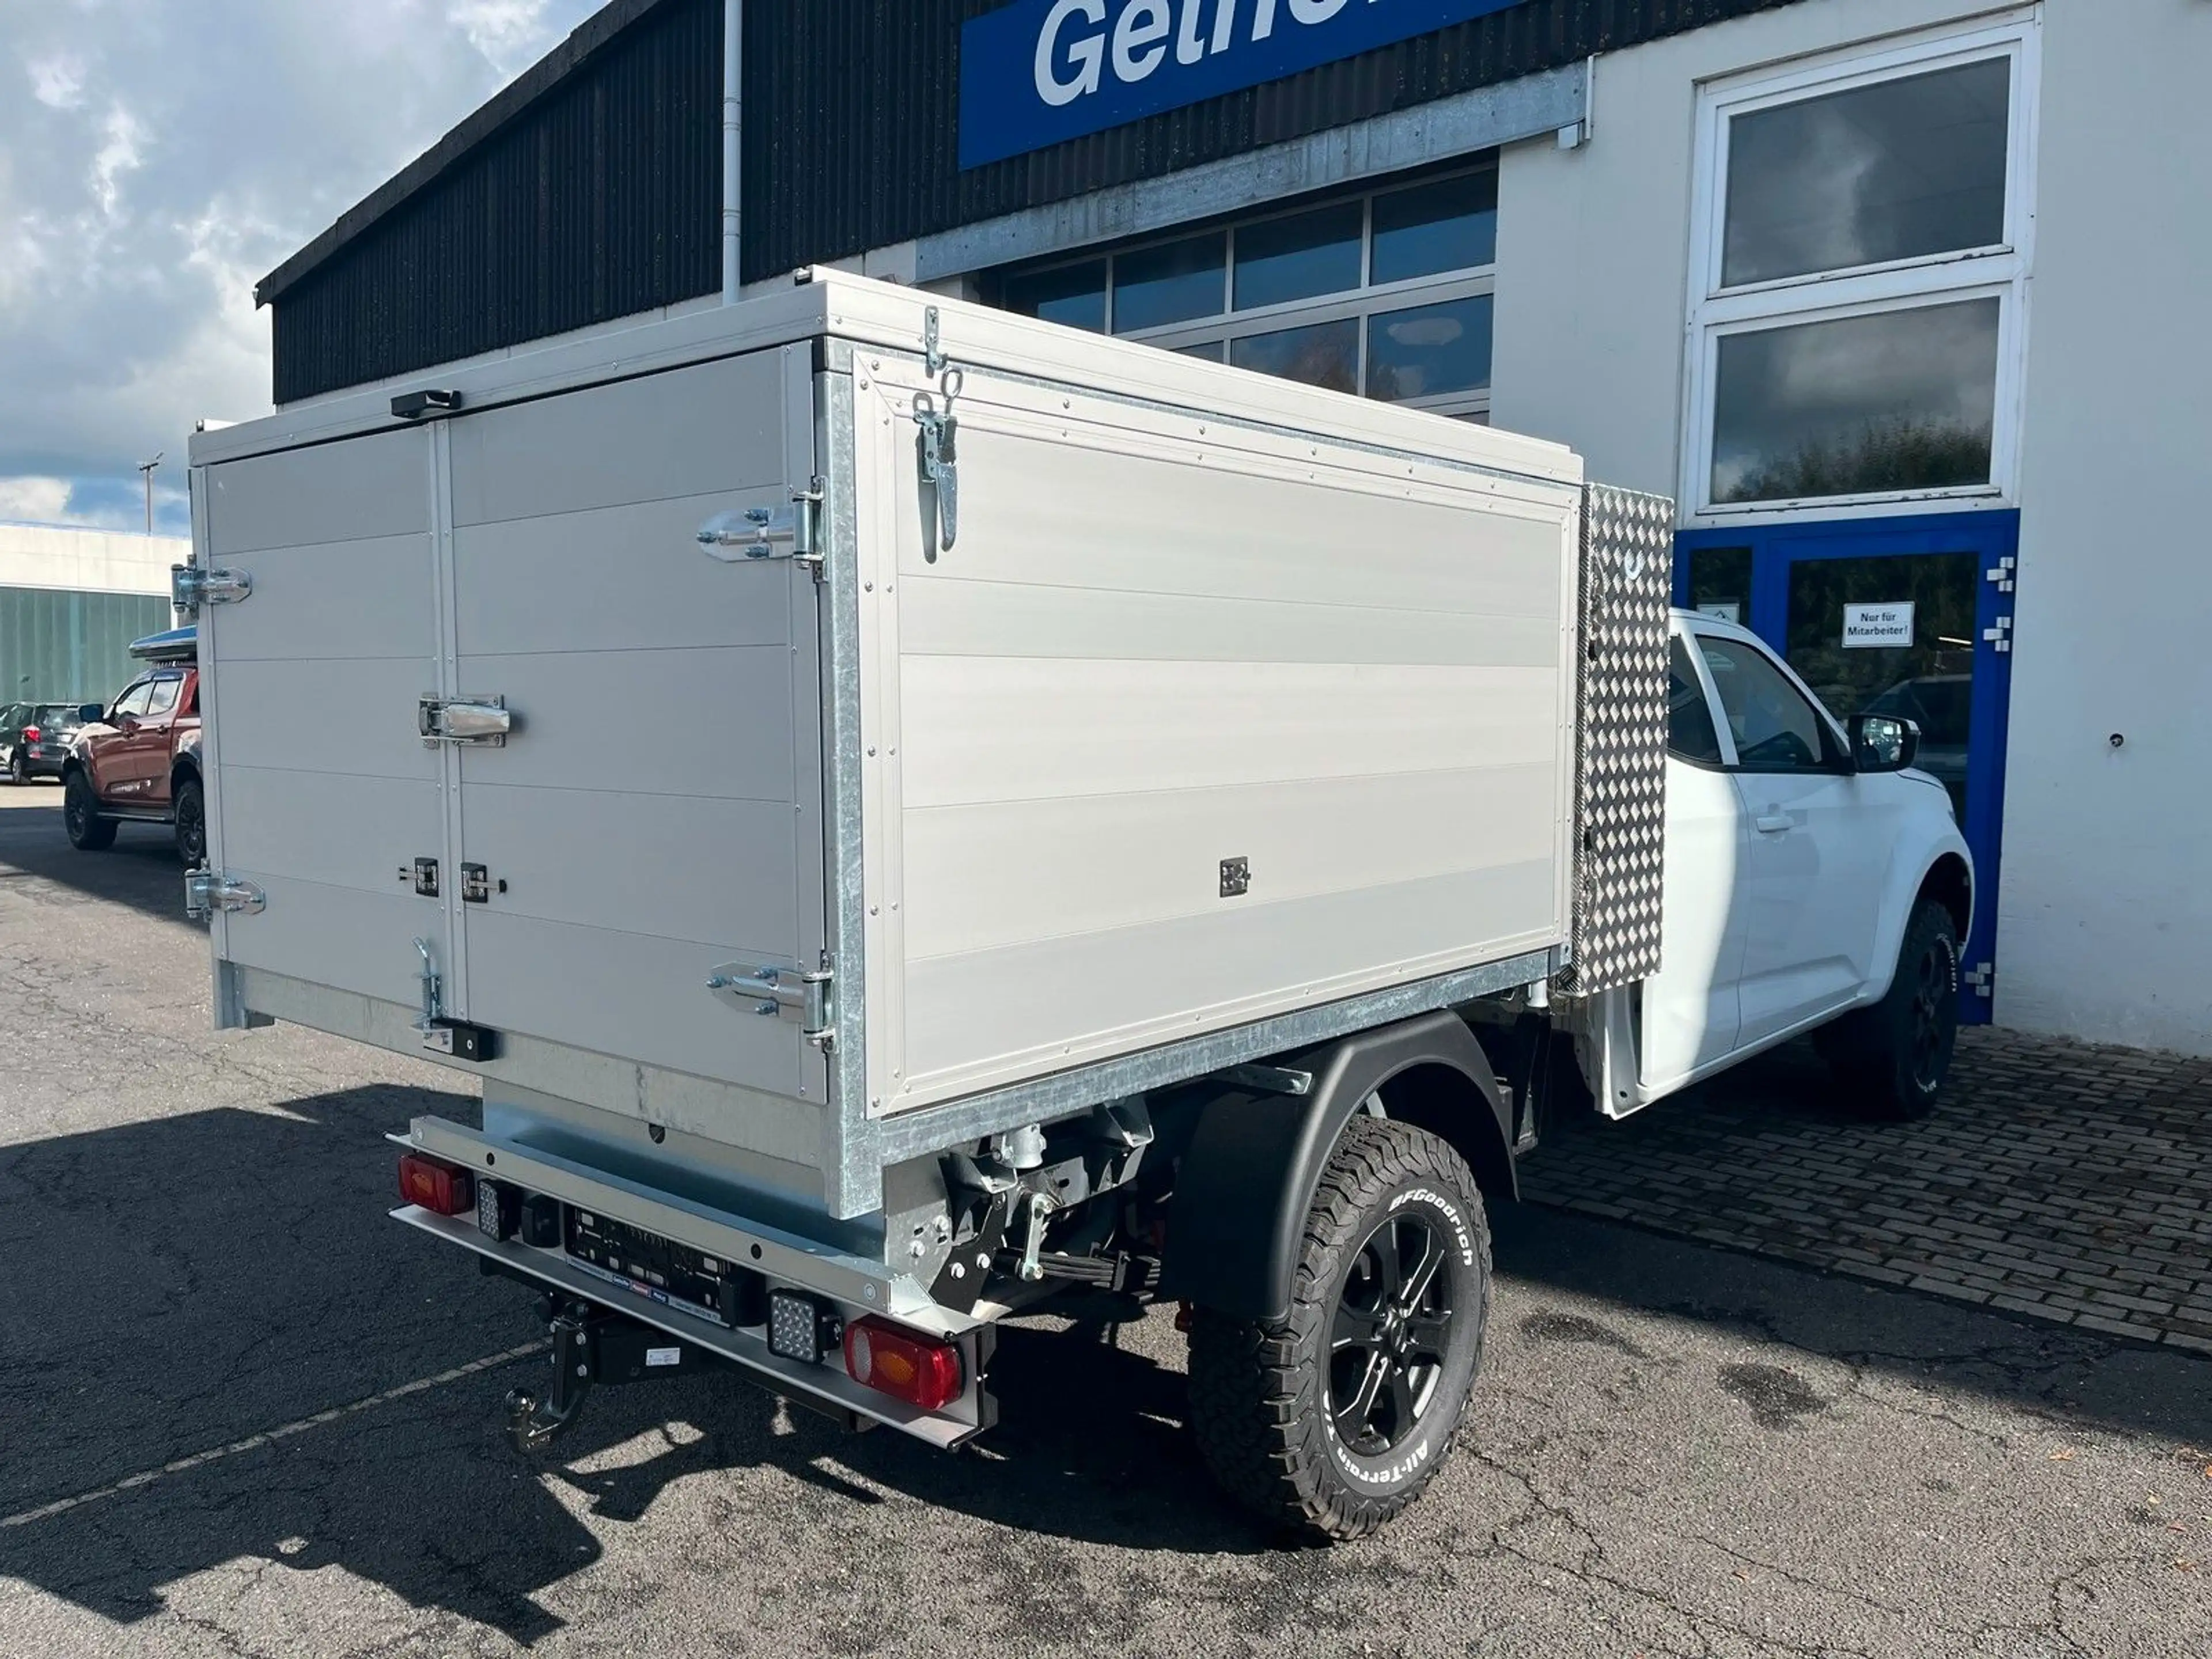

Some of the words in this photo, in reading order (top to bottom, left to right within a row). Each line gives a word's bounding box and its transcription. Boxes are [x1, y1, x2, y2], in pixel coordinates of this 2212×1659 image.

[1860, 612, 1879, 622] Nur
[1881, 612, 1896, 622] für
[1847, 625, 1908, 636] Mitarbeiter!
[1388, 1188, 1474, 1266] BFGoodrich
